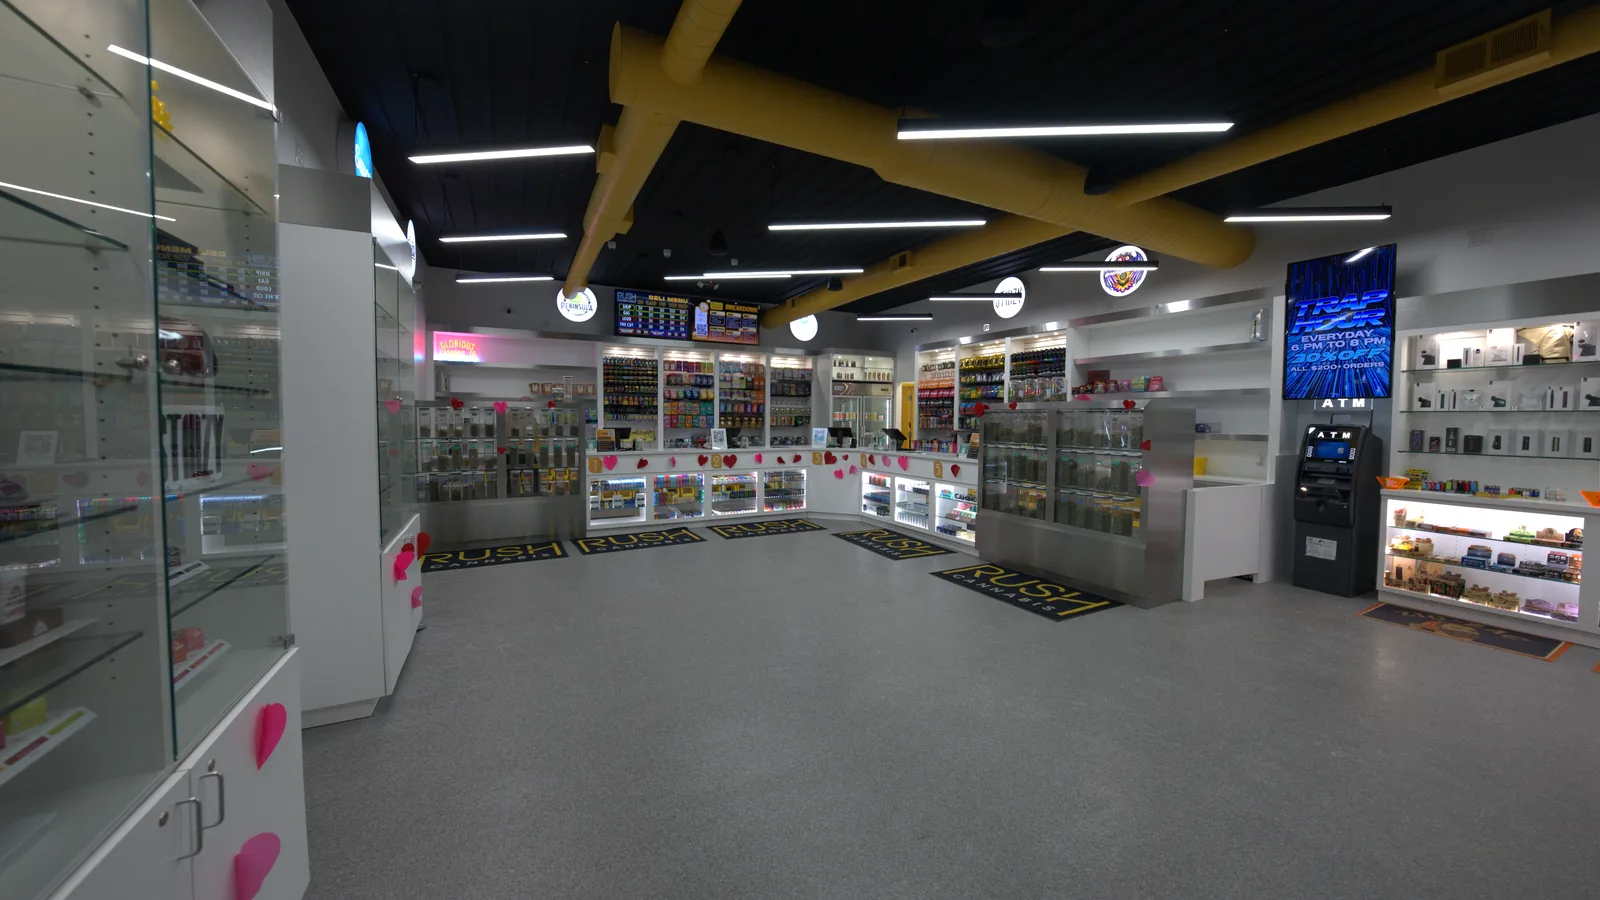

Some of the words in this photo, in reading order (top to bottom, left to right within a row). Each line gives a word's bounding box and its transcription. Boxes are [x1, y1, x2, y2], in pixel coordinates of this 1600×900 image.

[617, 292, 637, 303] RUSH
[1295, 289, 1389, 317] TRAP
[560, 302, 594, 312] PENINSULA
[725, 304, 758, 313] BREAKDOWN
[1291, 309, 1386, 334] HOUR
[1301, 329, 1374, 343] EVERYDAY
[439, 339, 476, 351] GLORIOUS
[1303, 342, 1323, 351] PM
[1326, 340, 1345, 348] TO
[1349, 339, 1359, 347] 8
[1364, 336, 1386, 346] PM
[1343, 361, 1385, 369] ORDERS
[1321, 398, 1365, 408] ATM
[1317, 431, 1351, 439] ATM
[712, 519, 818, 537] RUSH
[735, 526, 812, 537] CANNABIS
[577, 529, 700, 553] RUSH
[596, 538, 691, 551] CANNABIS
[842, 529, 945, 558] RUSH
[420, 542, 563, 568] RUSH
[429, 553, 551, 569] CANNABIS
[942, 564, 1110, 616] RUSH
[952, 573, 1055, 612] CANNABIS
